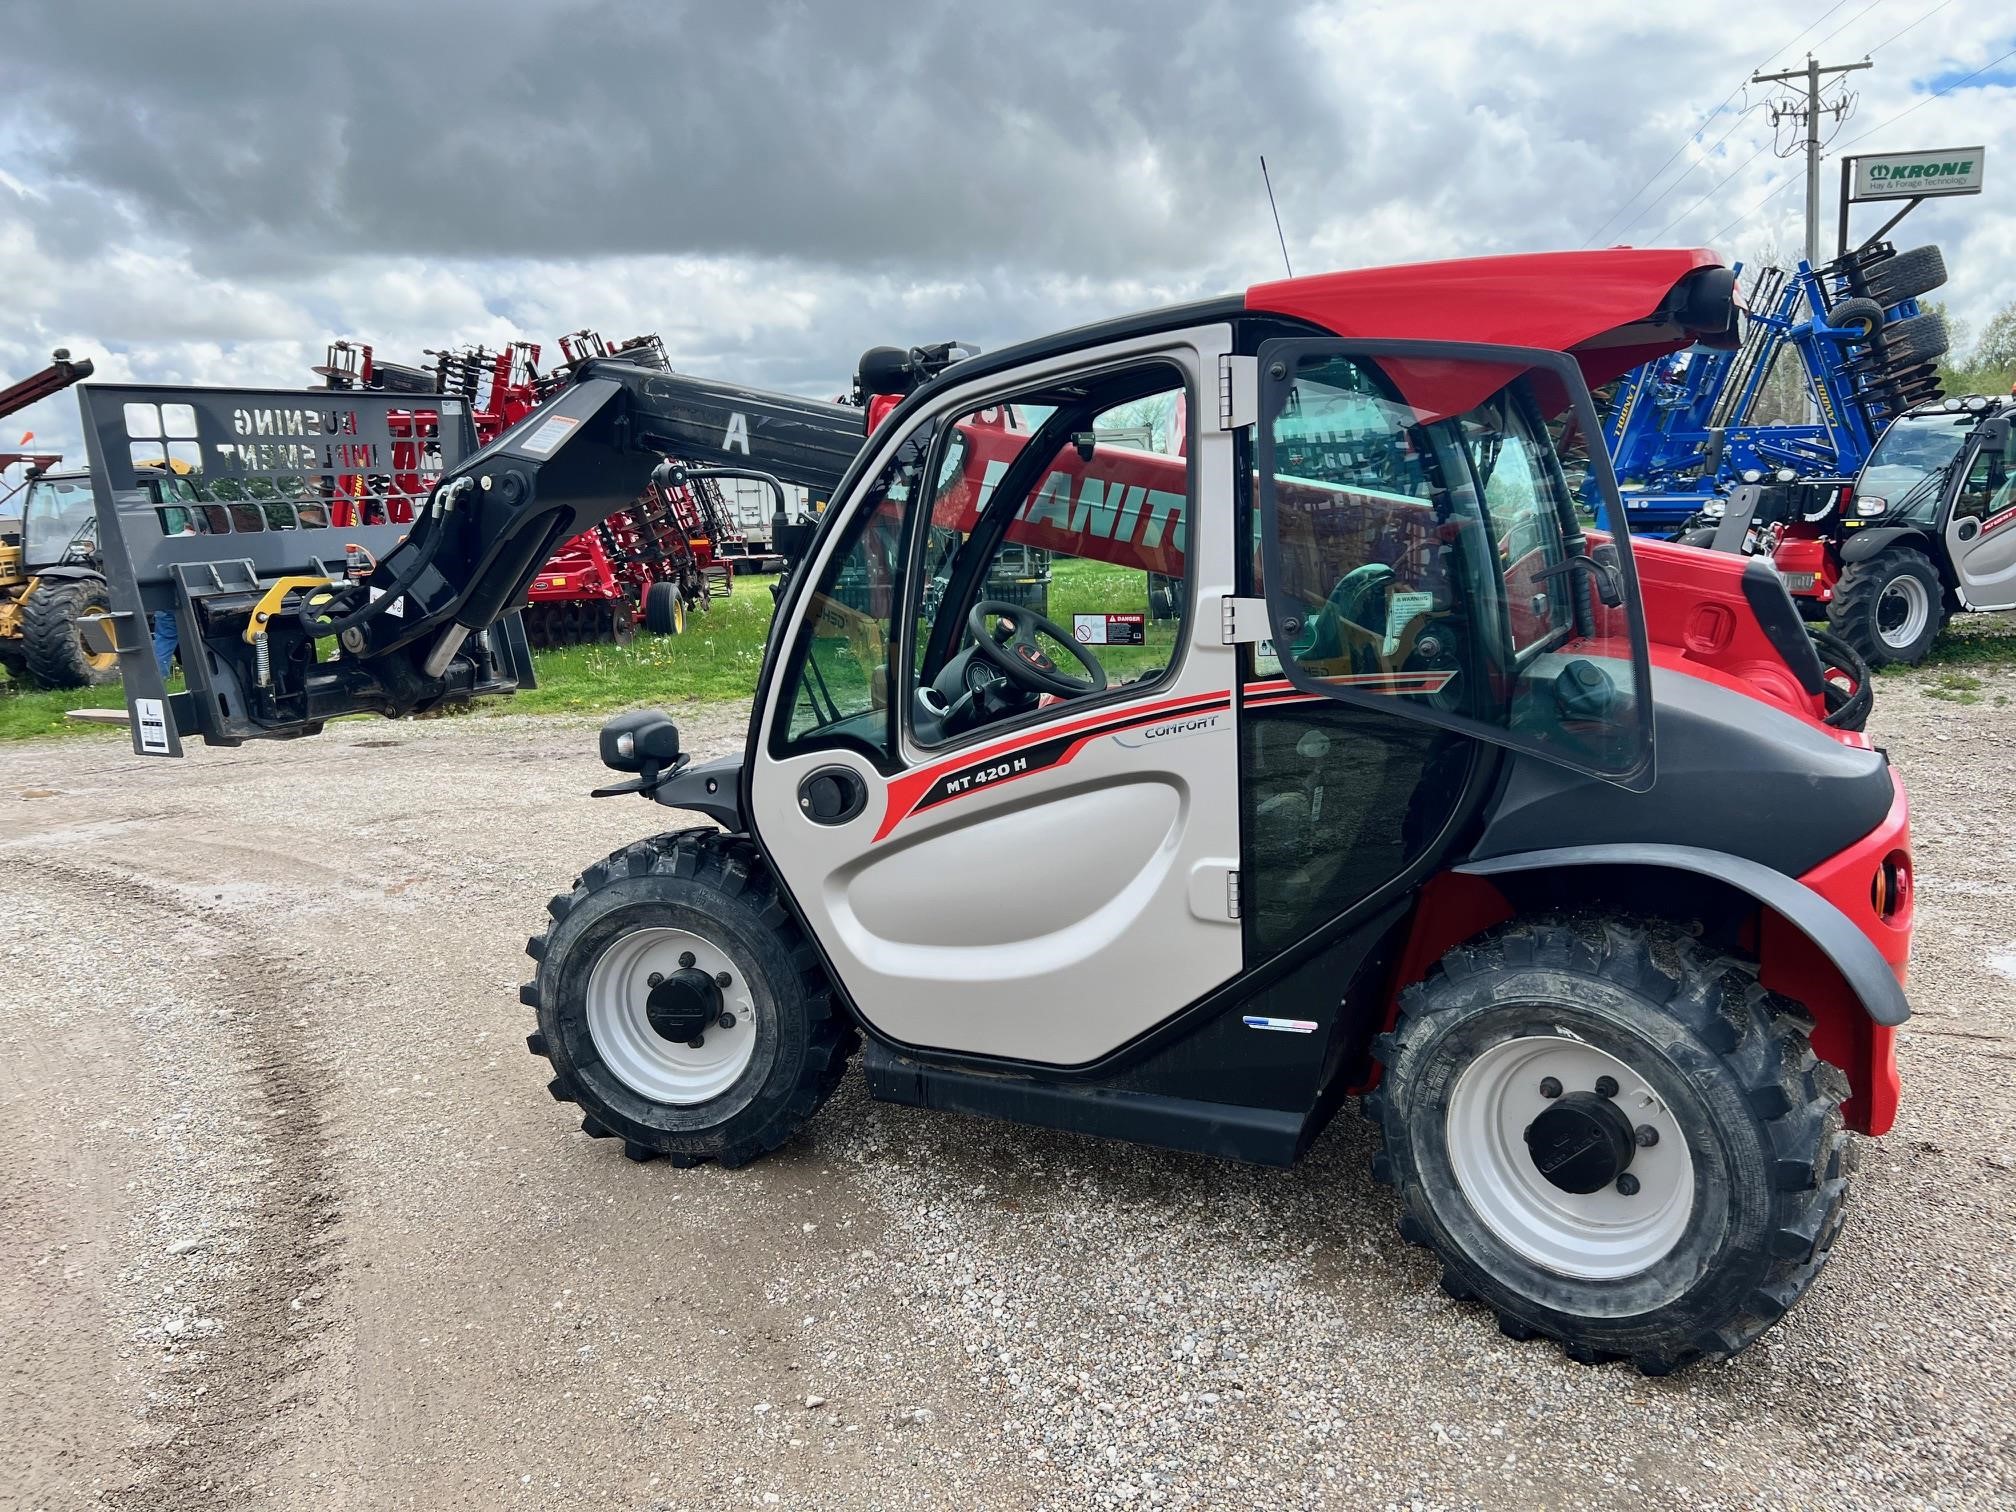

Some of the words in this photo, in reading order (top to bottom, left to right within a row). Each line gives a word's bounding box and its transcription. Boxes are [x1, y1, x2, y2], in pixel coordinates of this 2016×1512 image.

[1870, 182, 1884, 191] Hay
[1895, 180, 1922, 189] Forage
[1925, 177, 1968, 187] Technology
[1890, 161, 1974, 180] KRONE
[1613, 384, 1637, 438] LANDOLL
[1813, 375, 1838, 428] LANDOLL
[722, 412, 750, 455] A
[1144, 715, 1219, 739] COMFORT
[946, 776, 971, 794] MT
[975, 765, 1010, 784] 420
[1013, 757, 1028, 772] H
